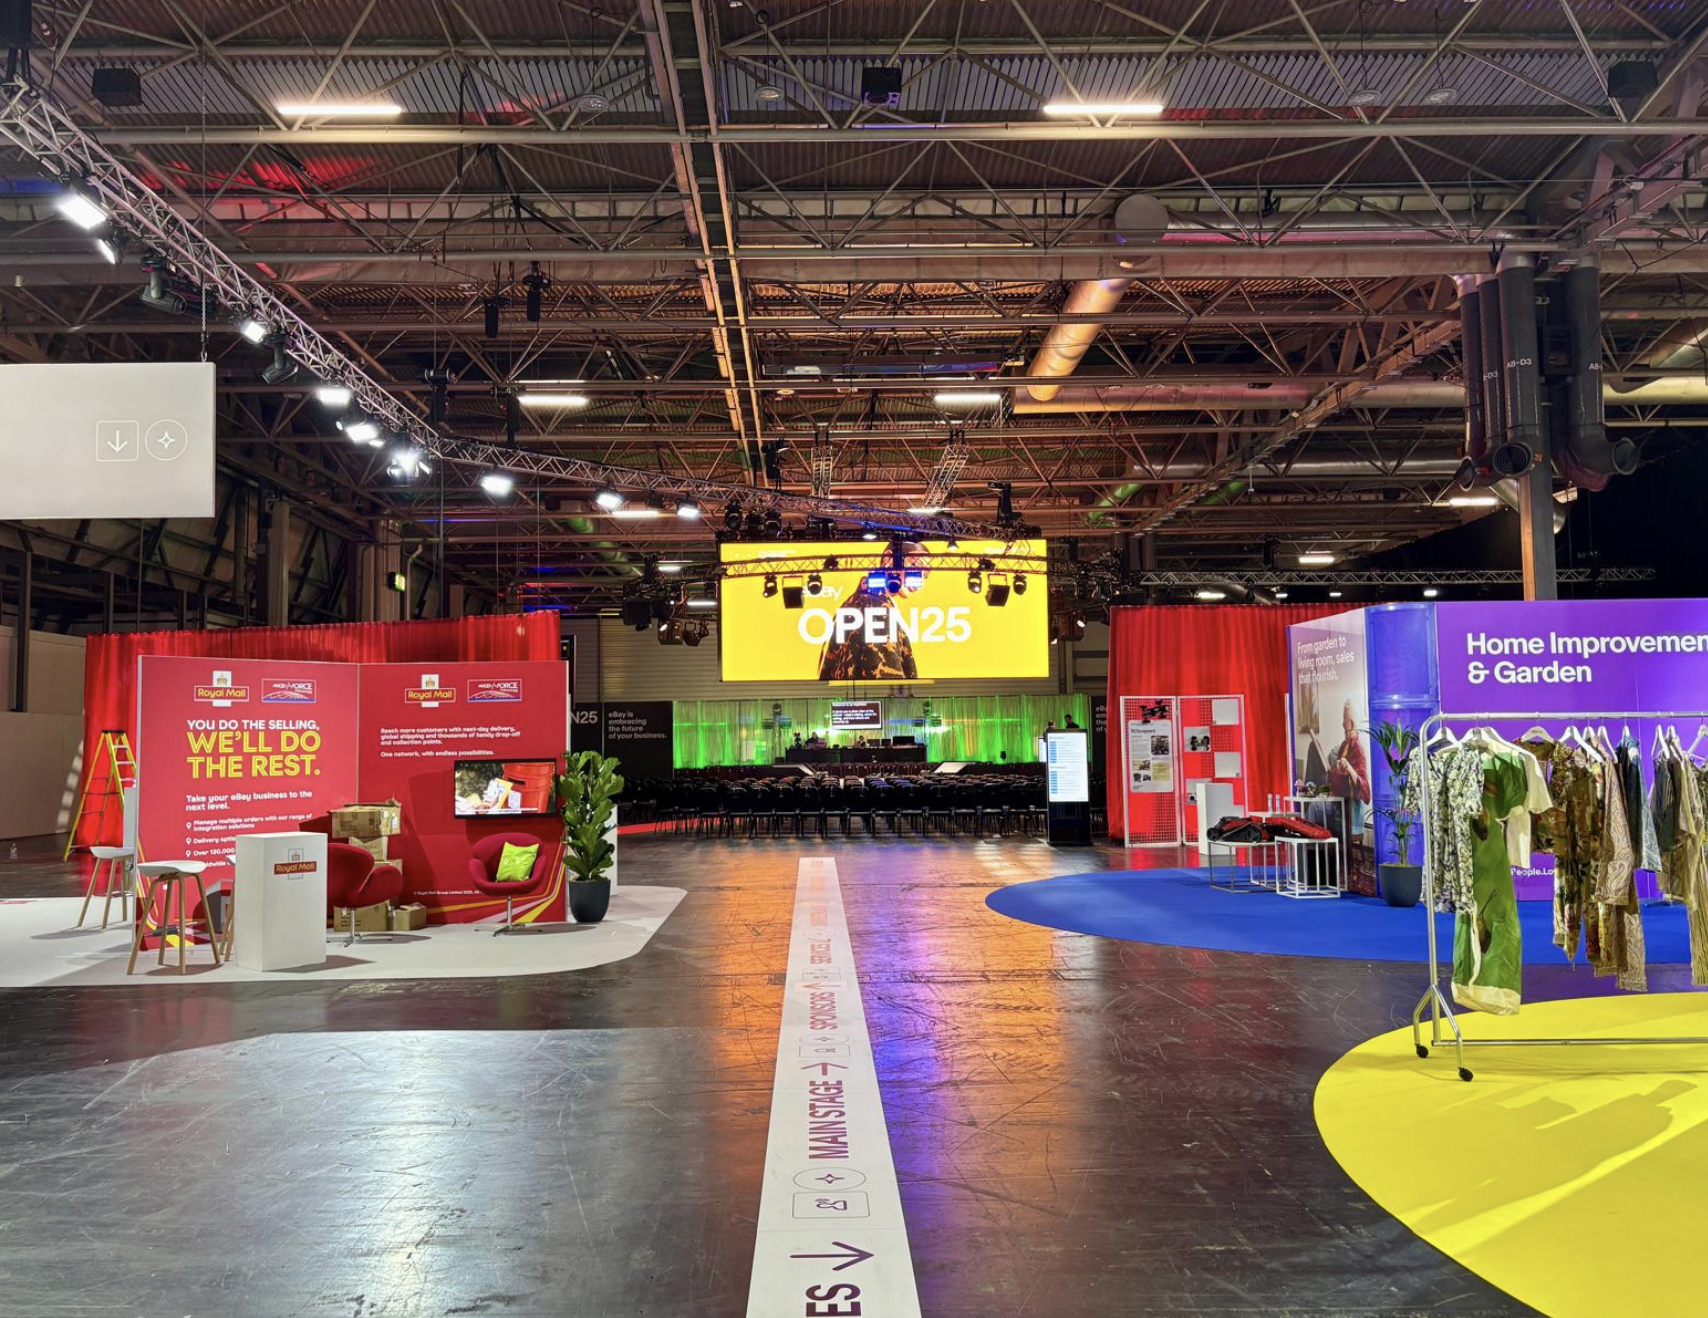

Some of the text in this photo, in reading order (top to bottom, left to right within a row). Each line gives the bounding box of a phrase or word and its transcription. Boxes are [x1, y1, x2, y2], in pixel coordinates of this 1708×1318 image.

[797, 606, 972, 645] OPEN25
[1297, 635, 1347, 655] From garden to
[1466, 631, 1708, 659] Home Improvemen
[1297, 651, 1354, 670] living room, sales
[1298, 668, 1339, 684] that flourish.
[1467, 659, 1592, 685] & Garden
[197, 688, 246, 698] Royal Mail
[408, 690, 452, 699] Royal Mail
[608, 711, 626, 719] eBay
[608, 718, 647, 726] embracing
[187, 719, 320, 731] YOU DO THE SELLING,
[280, 730, 321, 752] DO
[186, 754, 321, 779] THE REST.
[186, 790, 313, 803] Take your eBay business to the
[185, 802, 230, 811] next level.
[276, 862, 315, 873] Royal Mail
[809, 991, 838, 1031] SPONSORS
[808, 1080, 849, 1159] MAIN STAGE
[805, 1283, 862, 1318] ES
